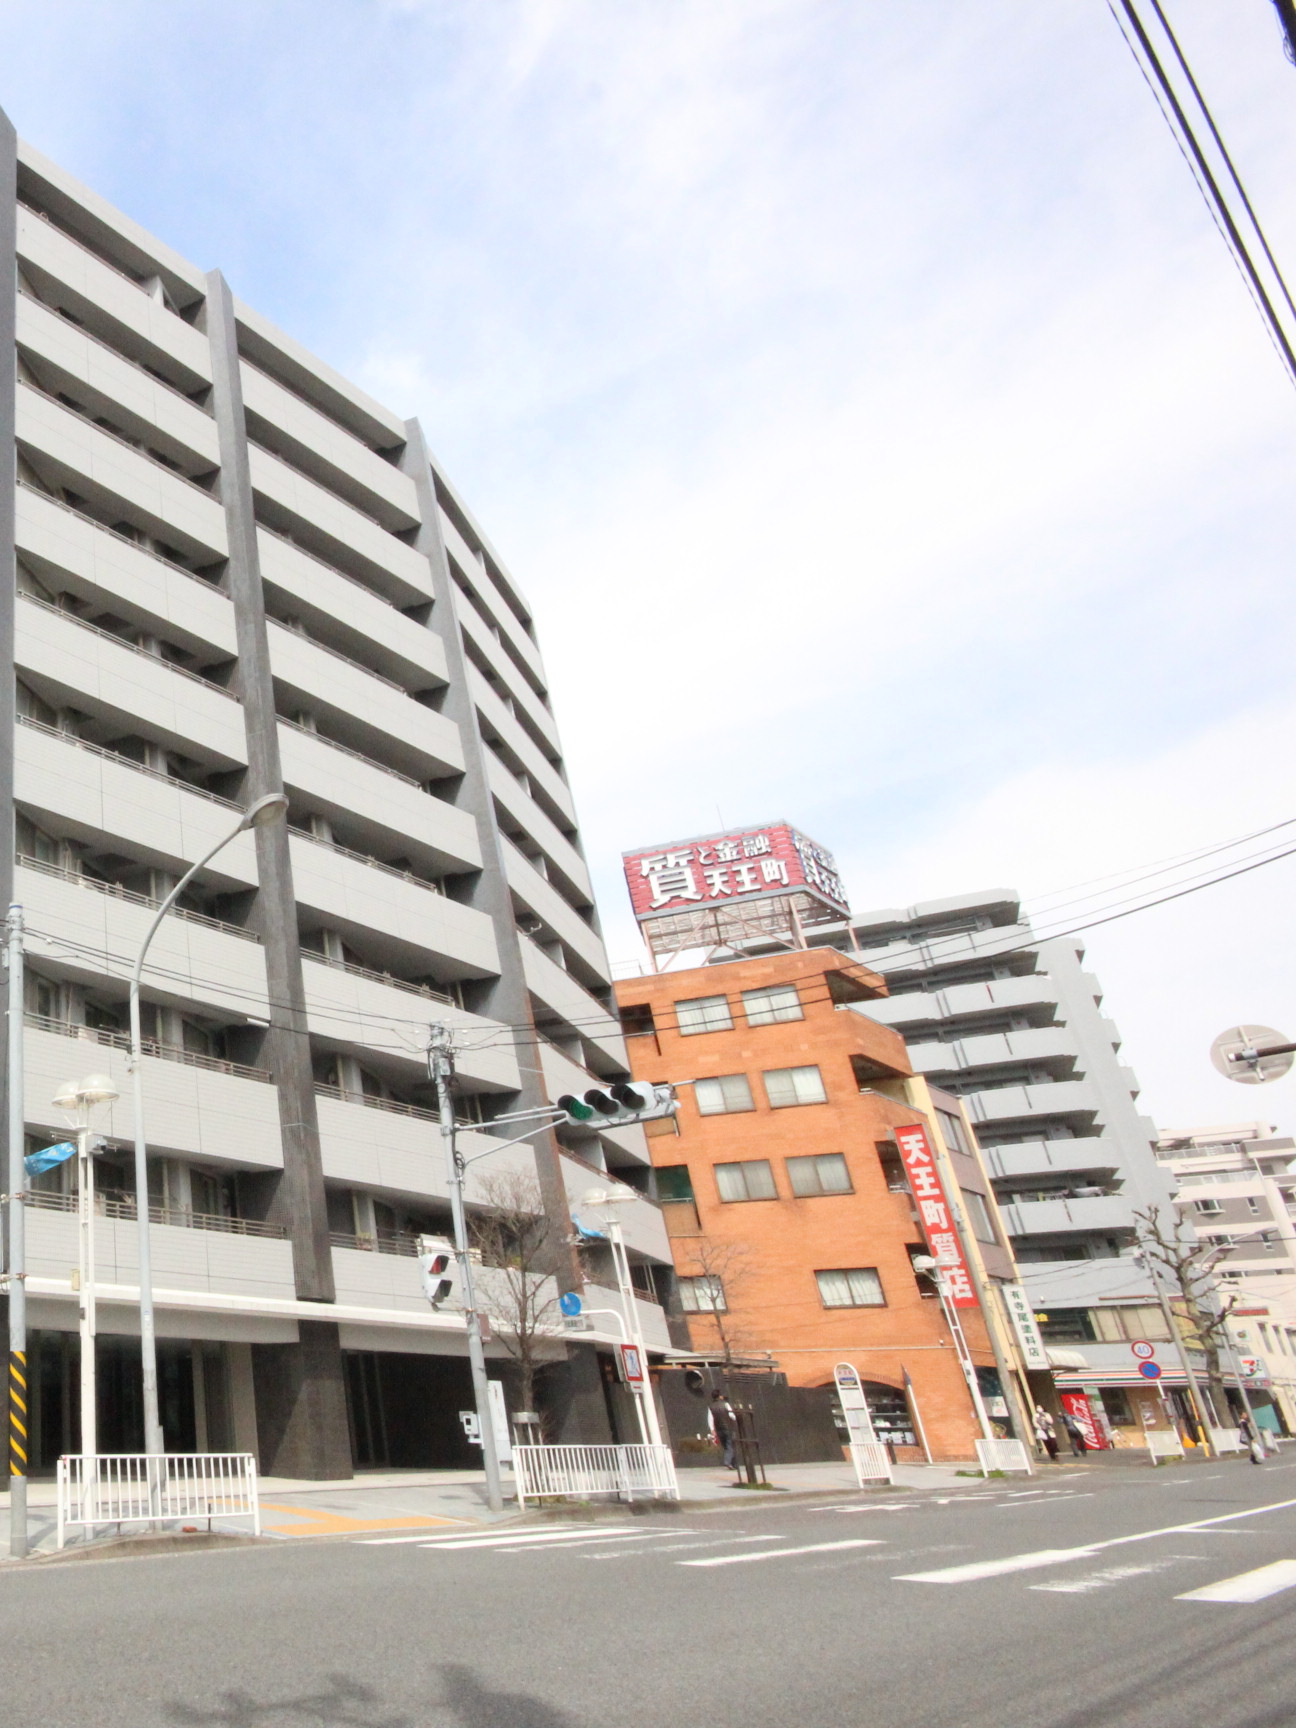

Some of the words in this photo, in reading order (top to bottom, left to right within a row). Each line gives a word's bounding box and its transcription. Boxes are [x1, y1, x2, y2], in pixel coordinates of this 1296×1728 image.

[696, 833, 772, 865] と金融
[640, 850, 705, 908] 質
[705, 857, 789, 897] 天王町
[900, 1133, 973, 1298] 天王町質店
